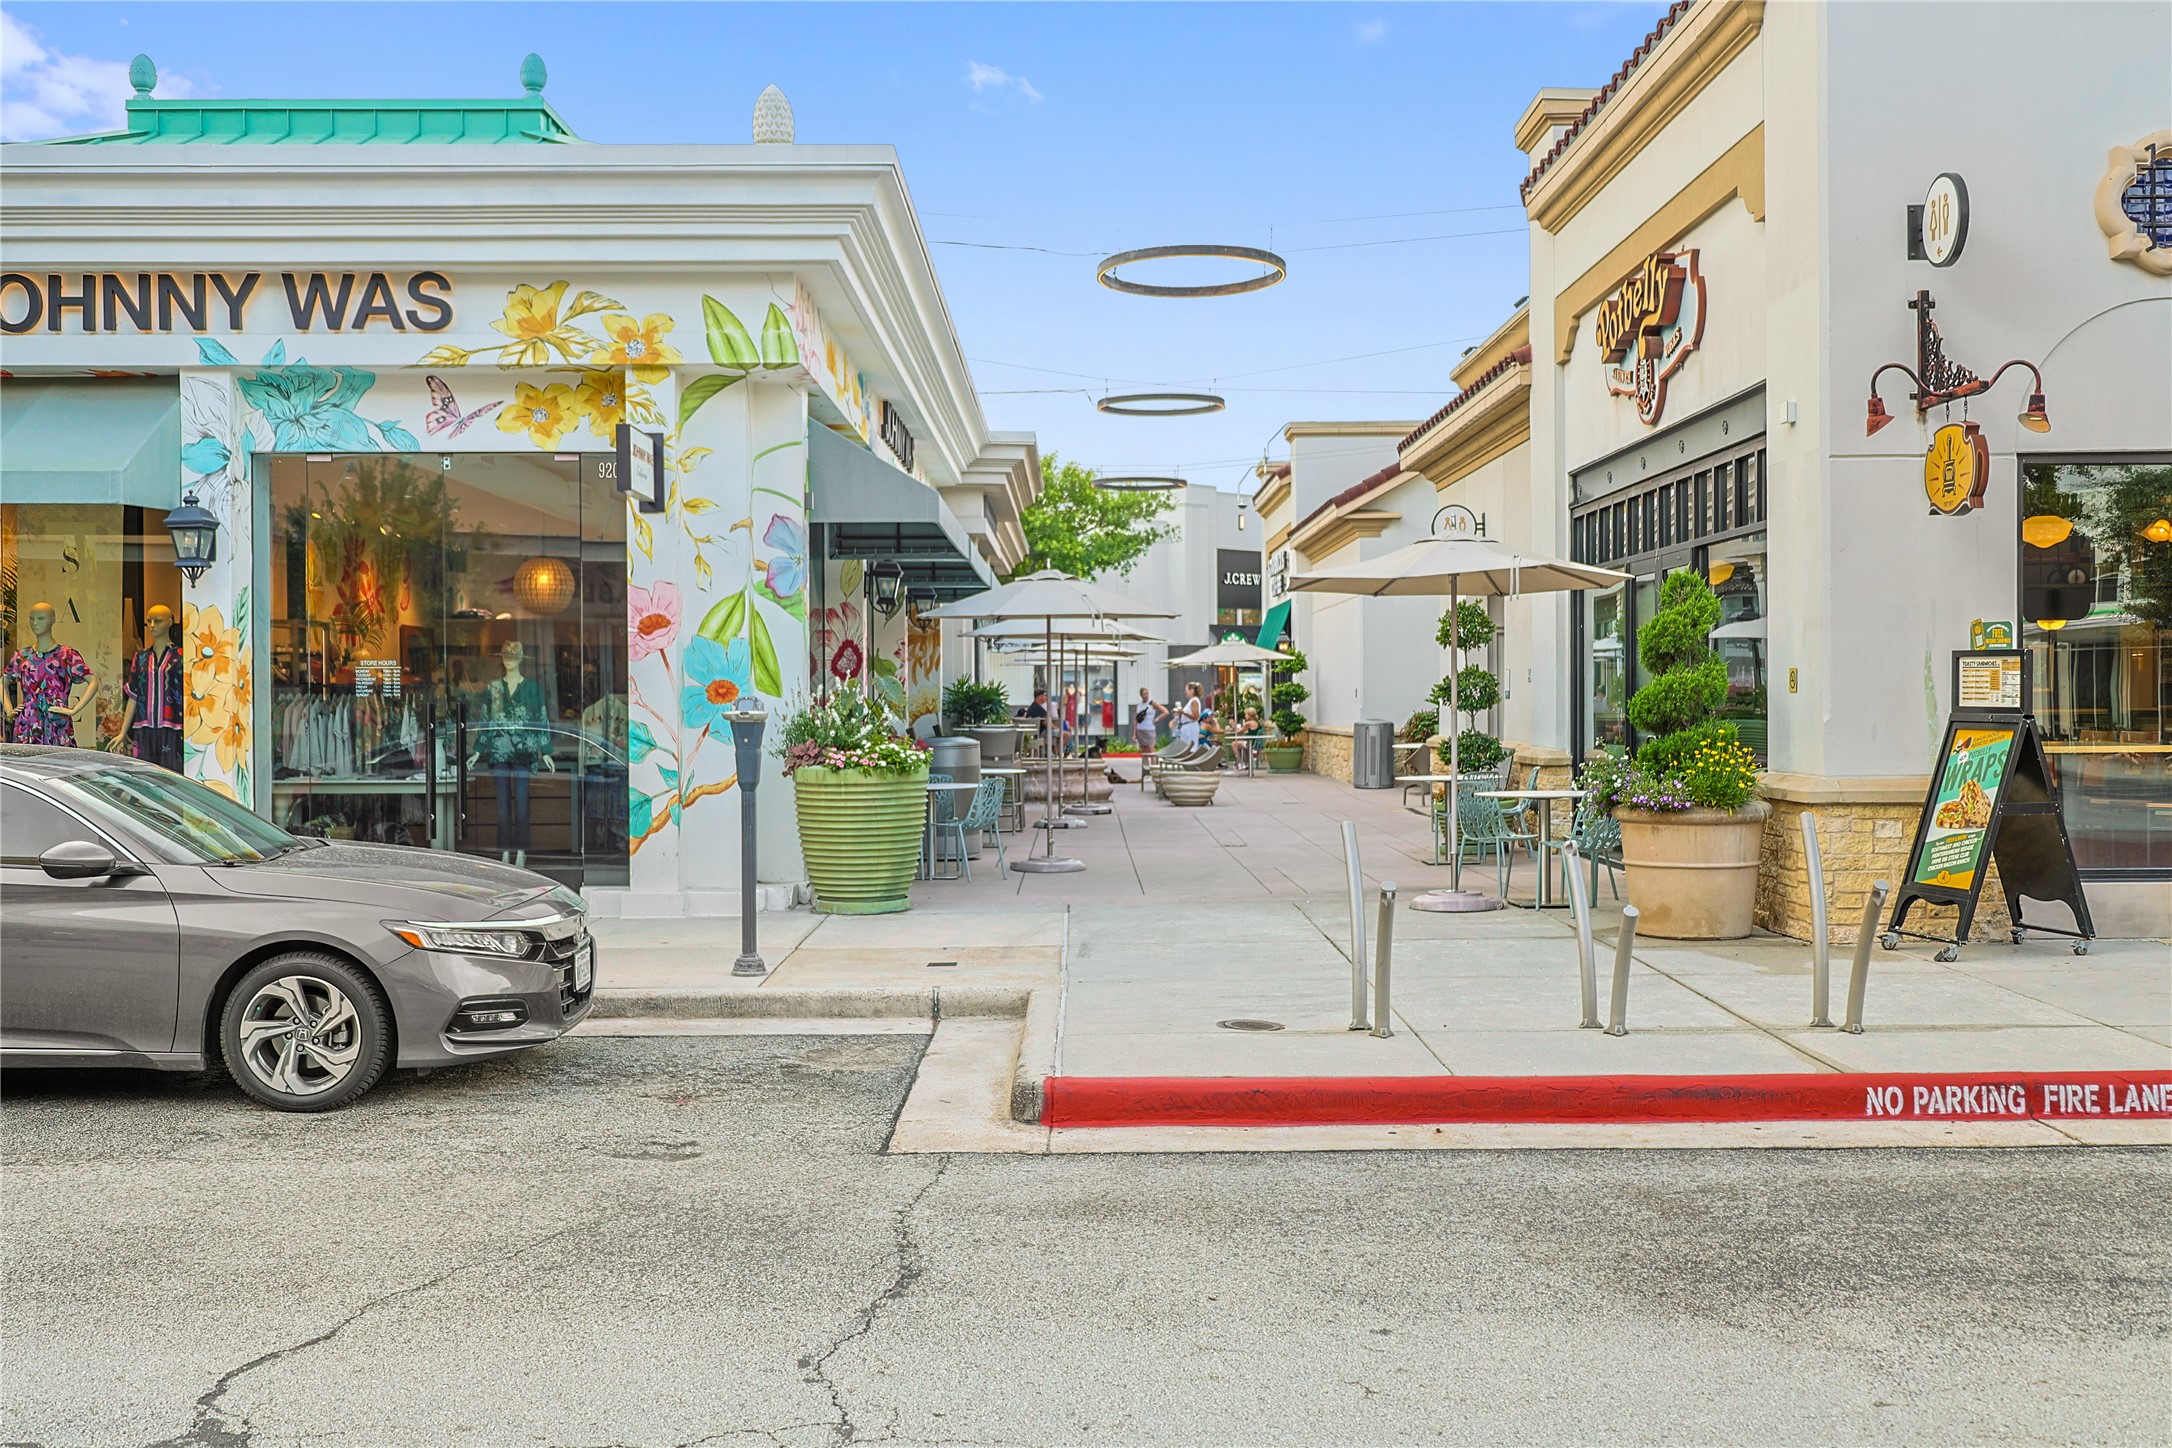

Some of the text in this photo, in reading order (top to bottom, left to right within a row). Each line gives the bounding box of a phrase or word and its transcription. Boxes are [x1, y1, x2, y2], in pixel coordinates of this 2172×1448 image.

[281, 270, 453, 332] WAS
[1596, 253, 1669, 364] Potbelly
[1223, 572, 1261, 586] J.CREW
[1992, 628, 2004, 638] FREE
[1943, 749, 2008, 793] WRAPS
[1866, 1084, 2172, 1116] NO PARKING FIRE LANE
